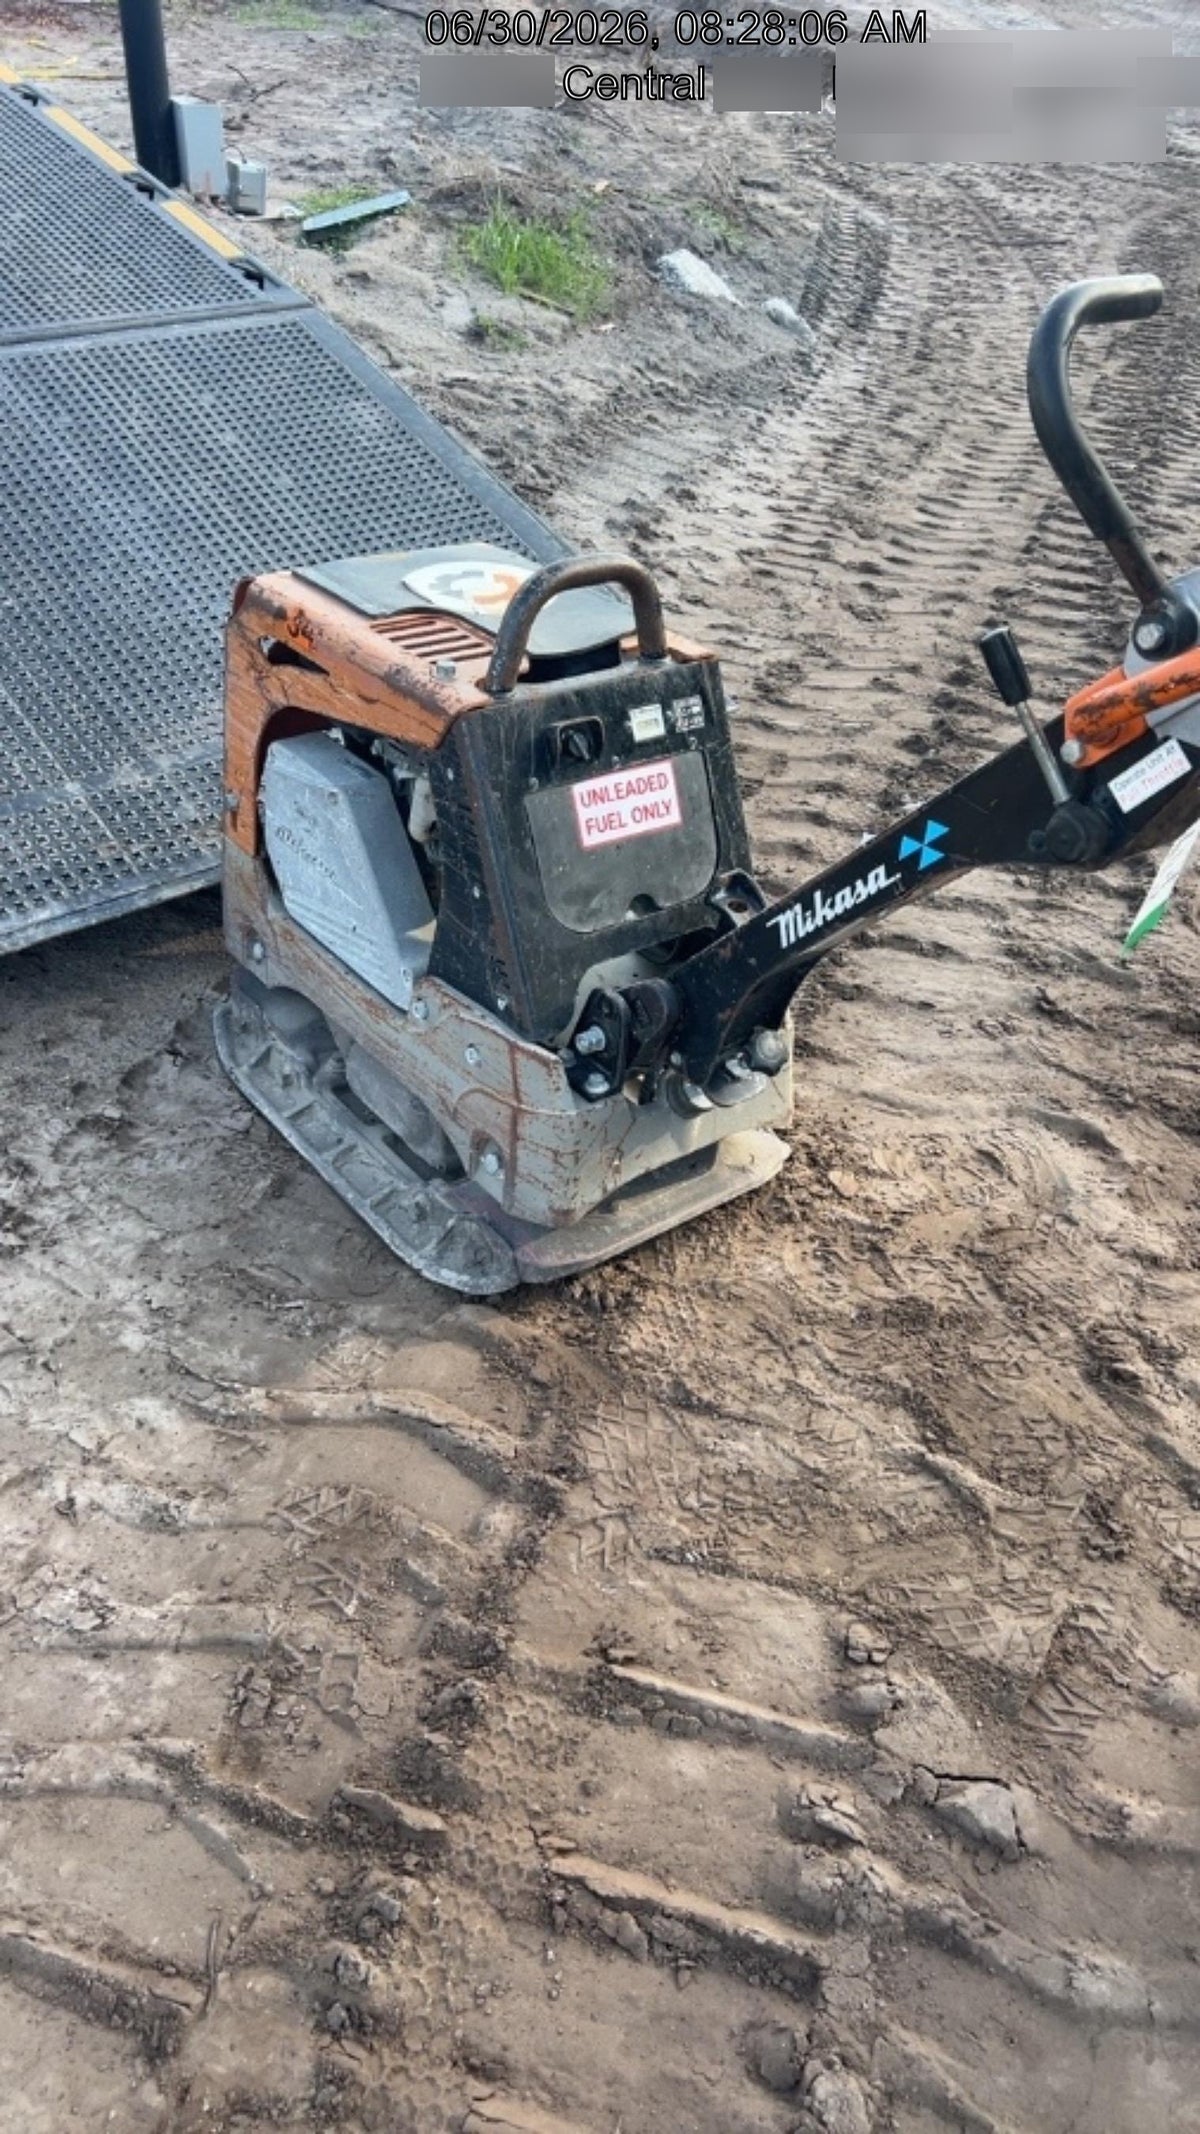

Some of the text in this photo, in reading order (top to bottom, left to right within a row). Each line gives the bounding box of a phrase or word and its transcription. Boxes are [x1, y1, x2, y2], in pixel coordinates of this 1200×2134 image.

[580, 772, 669, 807] UNLEADED
[585, 799, 672, 836] FUEL ONLY
[766, 863, 902, 949] Mikasa
